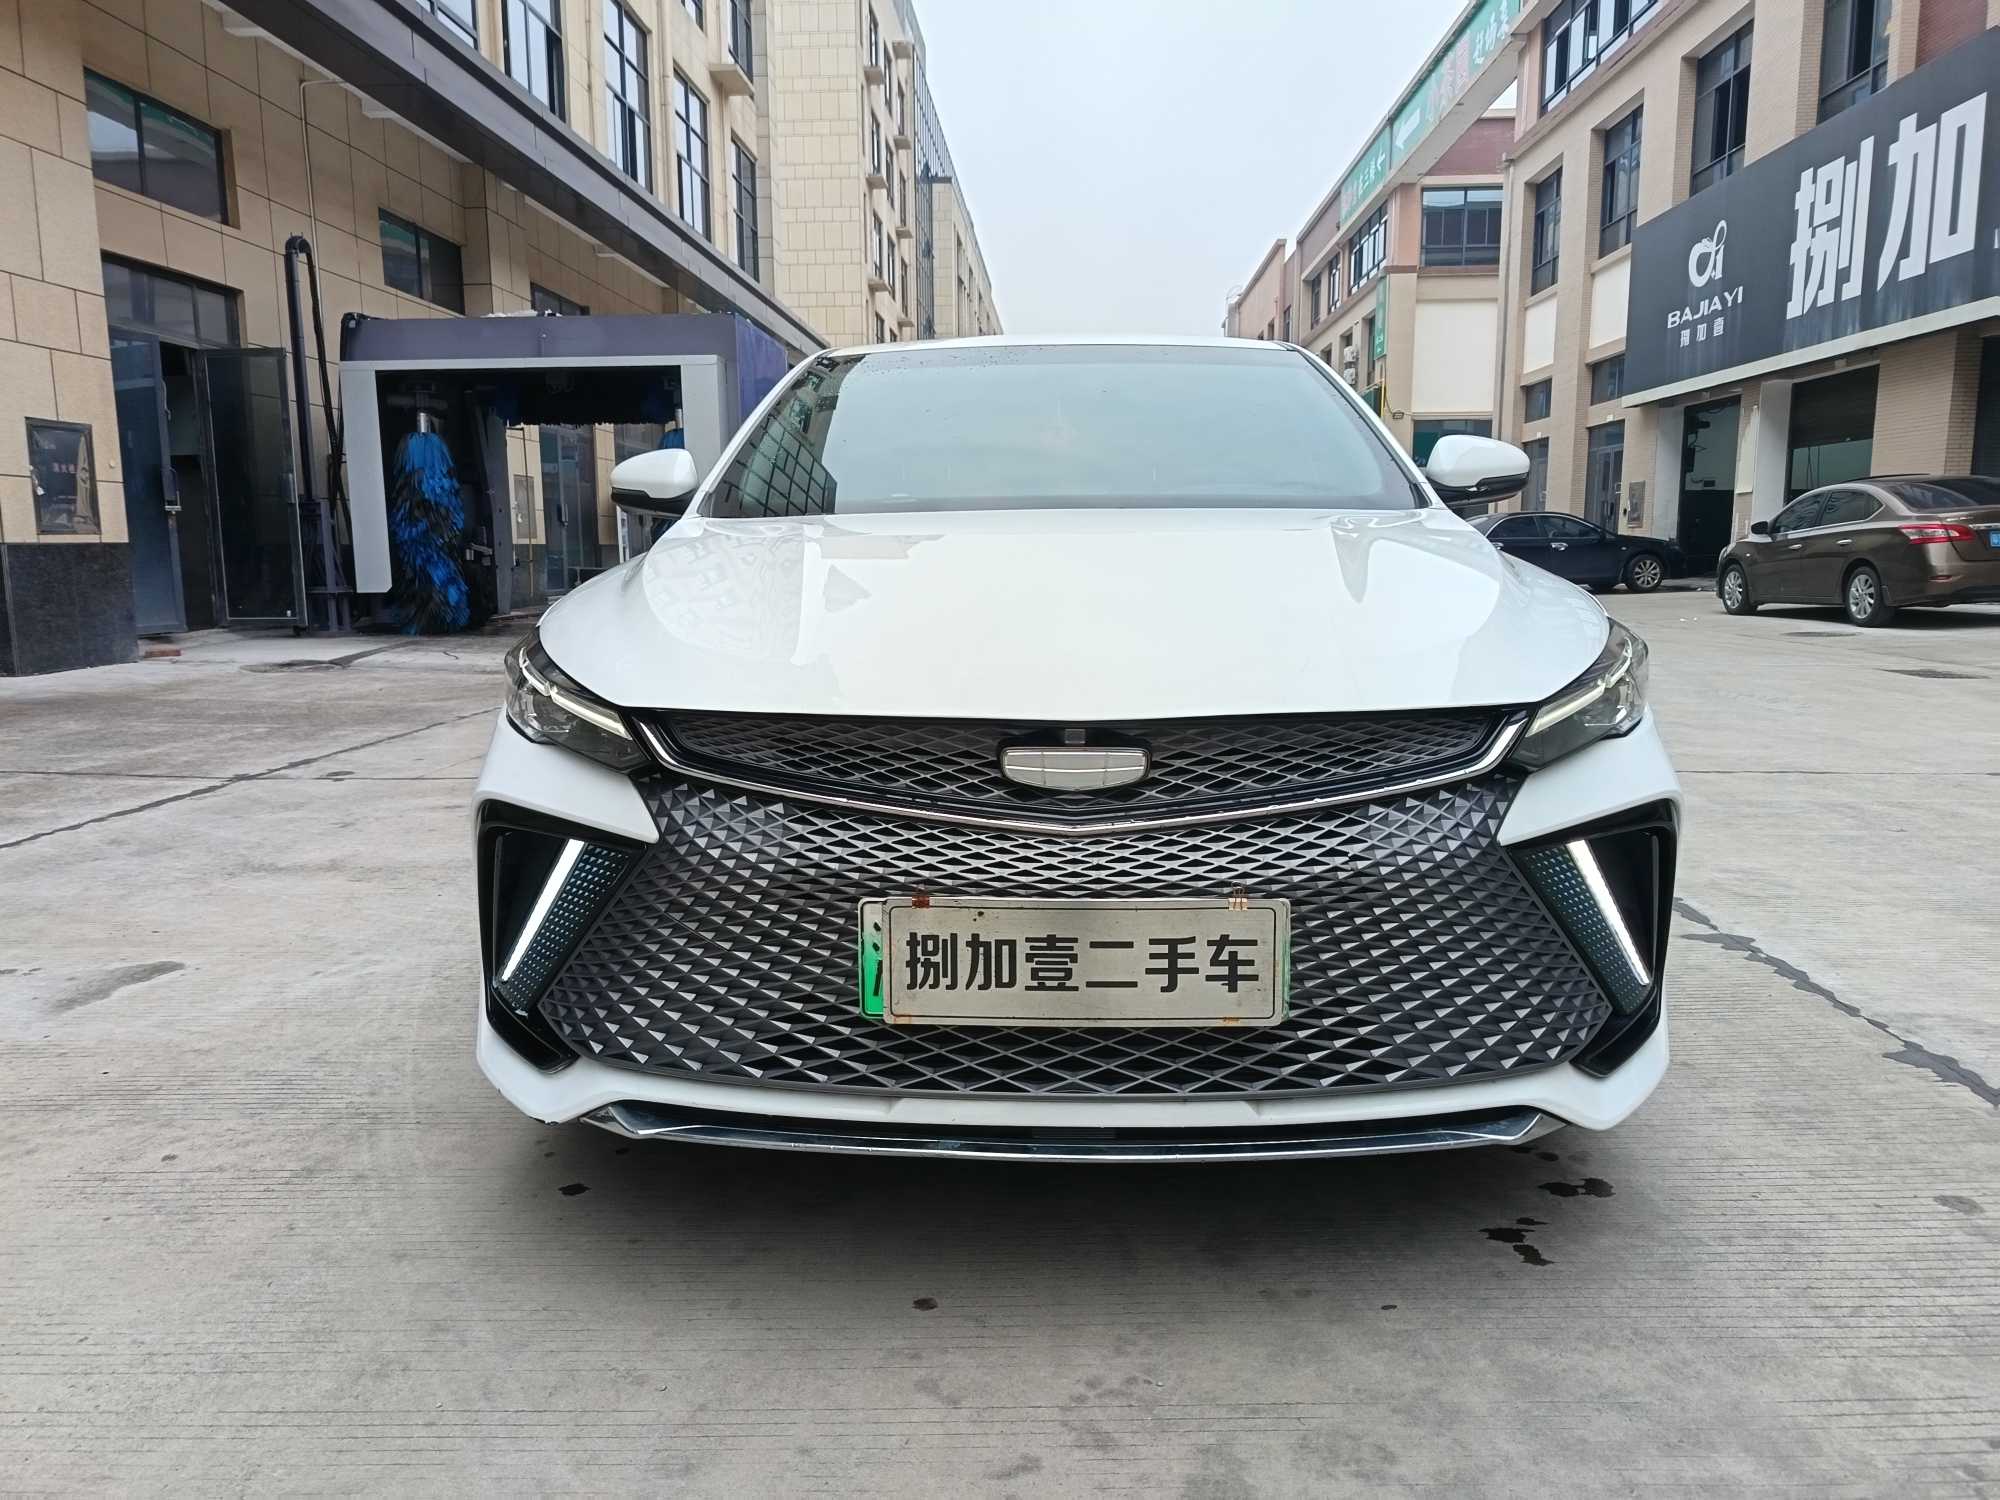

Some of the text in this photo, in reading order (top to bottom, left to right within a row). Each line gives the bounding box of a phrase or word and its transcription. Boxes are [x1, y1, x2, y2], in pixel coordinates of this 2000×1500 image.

[1786, 92, 2000, 319] 捌加
[1667, 286, 1743, 328] BAJIAYI
[905, 931, 1259, 993] 捌加壹二手车
